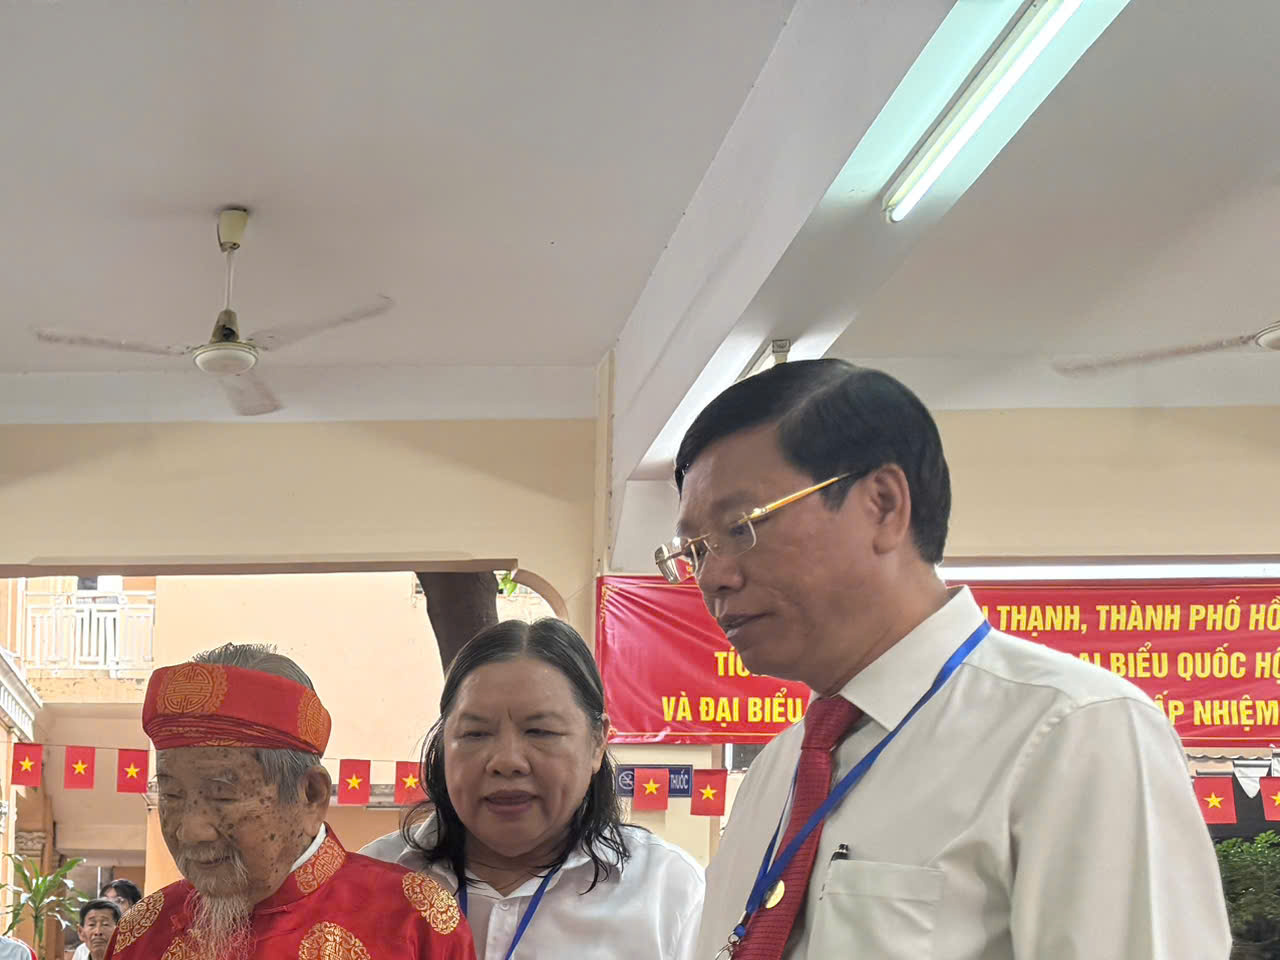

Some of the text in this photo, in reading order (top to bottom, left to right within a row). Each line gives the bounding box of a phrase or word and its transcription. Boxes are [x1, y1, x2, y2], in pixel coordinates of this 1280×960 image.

[997, 605, 1088, 637] THẠNH,
[1096, 600, 1181, 631] THÀNH
[1188, 596, 1241, 631] PHỐ
[1111, 641, 1168, 678] BIỂU
[1177, 643, 1247, 681] QUỐC
[662, 687, 804, 728] VÀ ĐẠI BIỂU
[1193, 694, 1280, 732] NHIỆM
